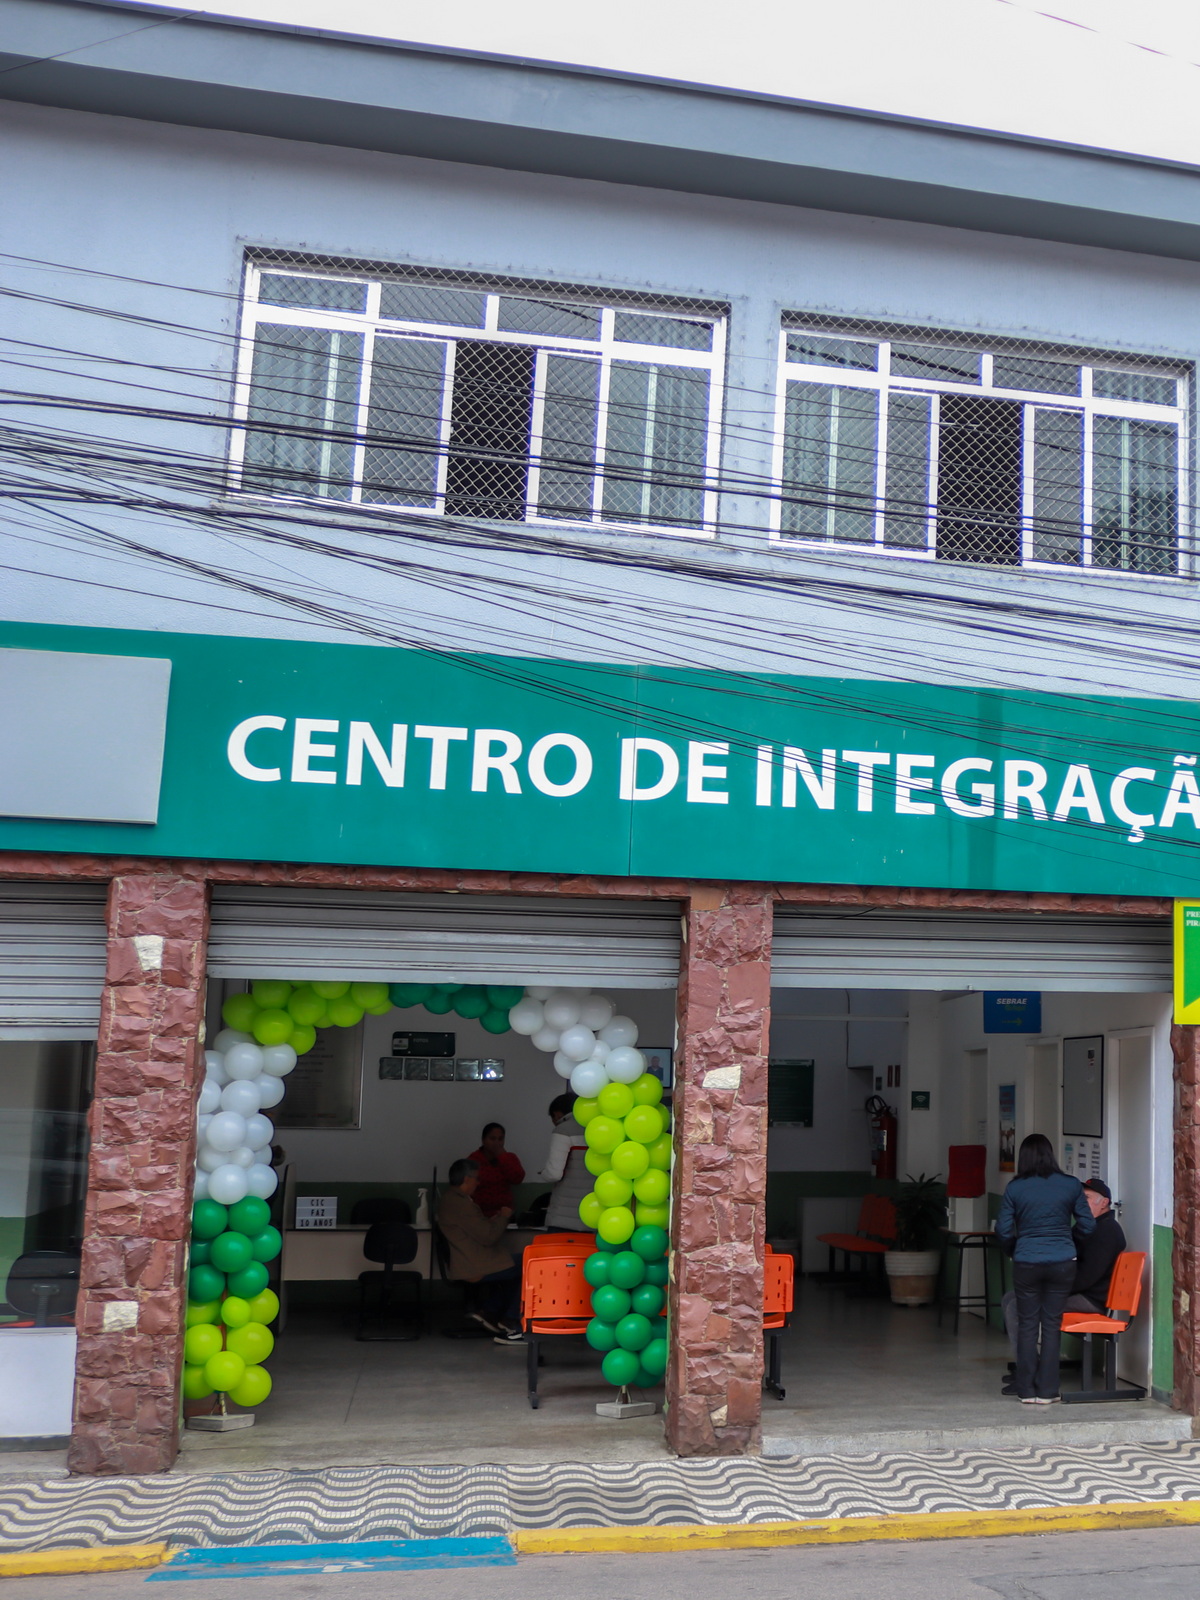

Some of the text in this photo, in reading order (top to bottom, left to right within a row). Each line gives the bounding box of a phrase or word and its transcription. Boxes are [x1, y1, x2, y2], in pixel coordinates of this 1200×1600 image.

[228, 715, 593, 798] CENTRO
[620, 737, 728, 805] DE
[996, 997, 1028, 1005] SEBRAE
[310, 1199, 325, 1207] CIC
[310, 1209, 325, 1217] FAZ
[300, 1218, 333, 1227] 10 ANOS
